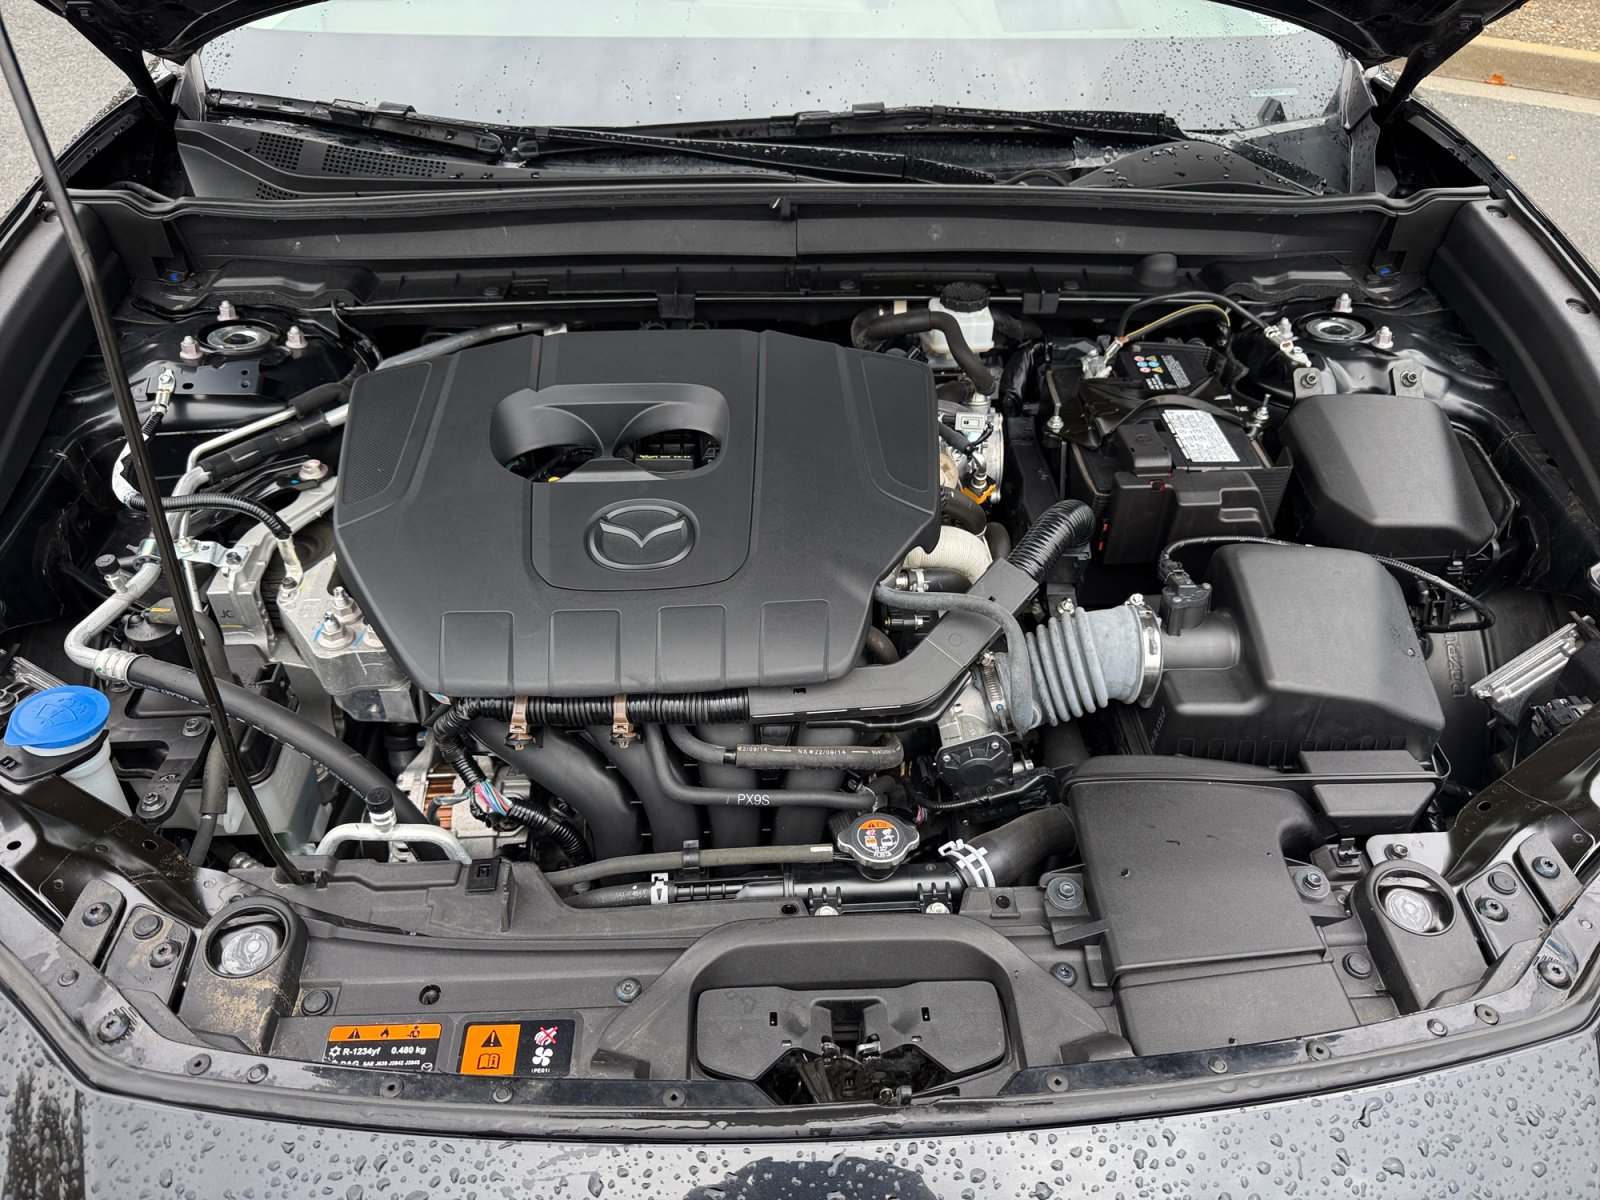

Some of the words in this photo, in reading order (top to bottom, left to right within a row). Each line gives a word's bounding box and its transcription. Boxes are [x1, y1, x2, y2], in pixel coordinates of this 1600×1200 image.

[737, 793, 770, 806] PX9S
[342, 1046, 382, 1057] R-1234yf
[390, 1045, 414, 1055] 0.480
[415, 1045, 427, 1055] kg
